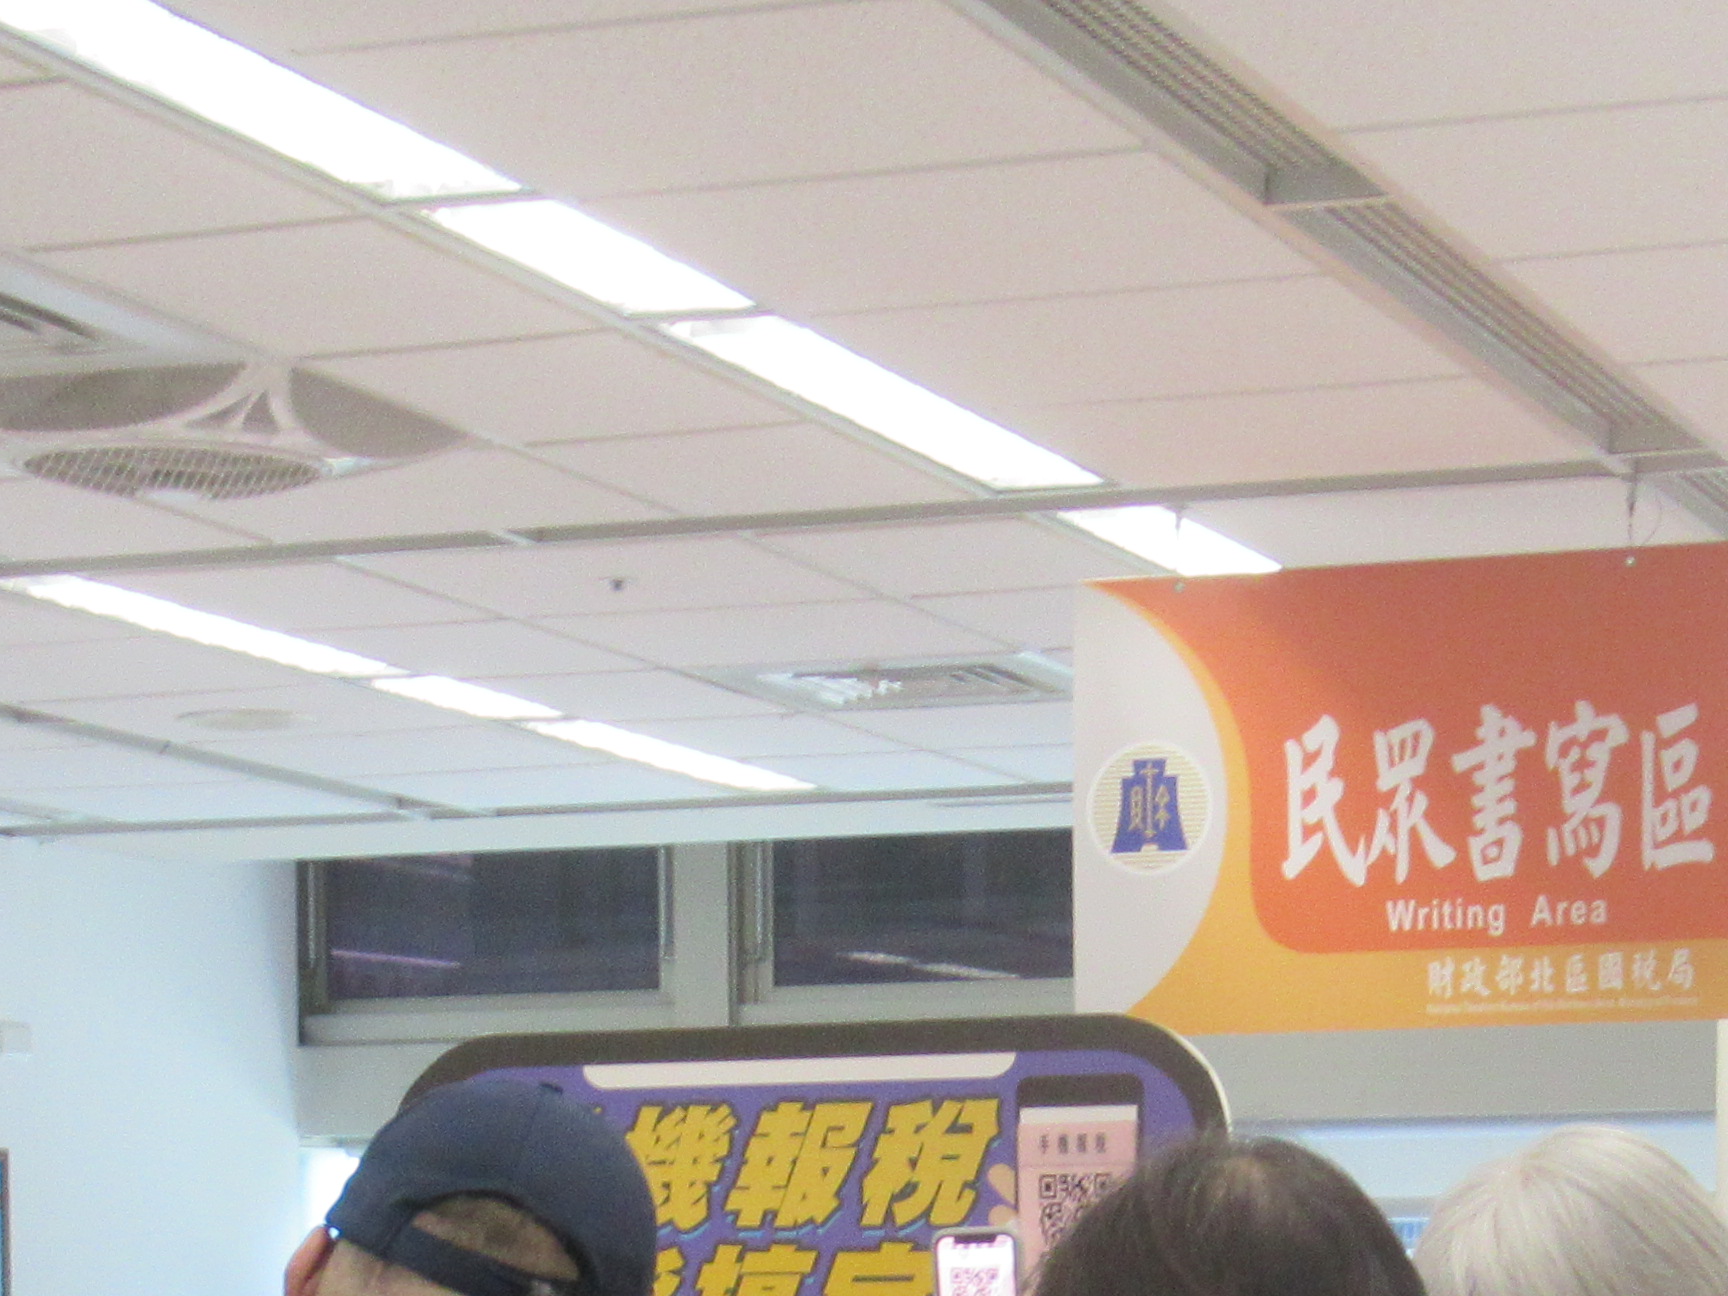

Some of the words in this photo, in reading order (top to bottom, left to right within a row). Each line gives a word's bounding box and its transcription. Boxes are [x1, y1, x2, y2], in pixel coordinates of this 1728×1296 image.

[1282, 701, 1714, 887] 民眾書寫區
[1385, 899, 1505, 937] Writing
[1529, 895, 1608, 928] Area
[1428, 948, 1695, 998] 財政部北區國稅局
[594, 1098, 999, 1232] 機報稅
